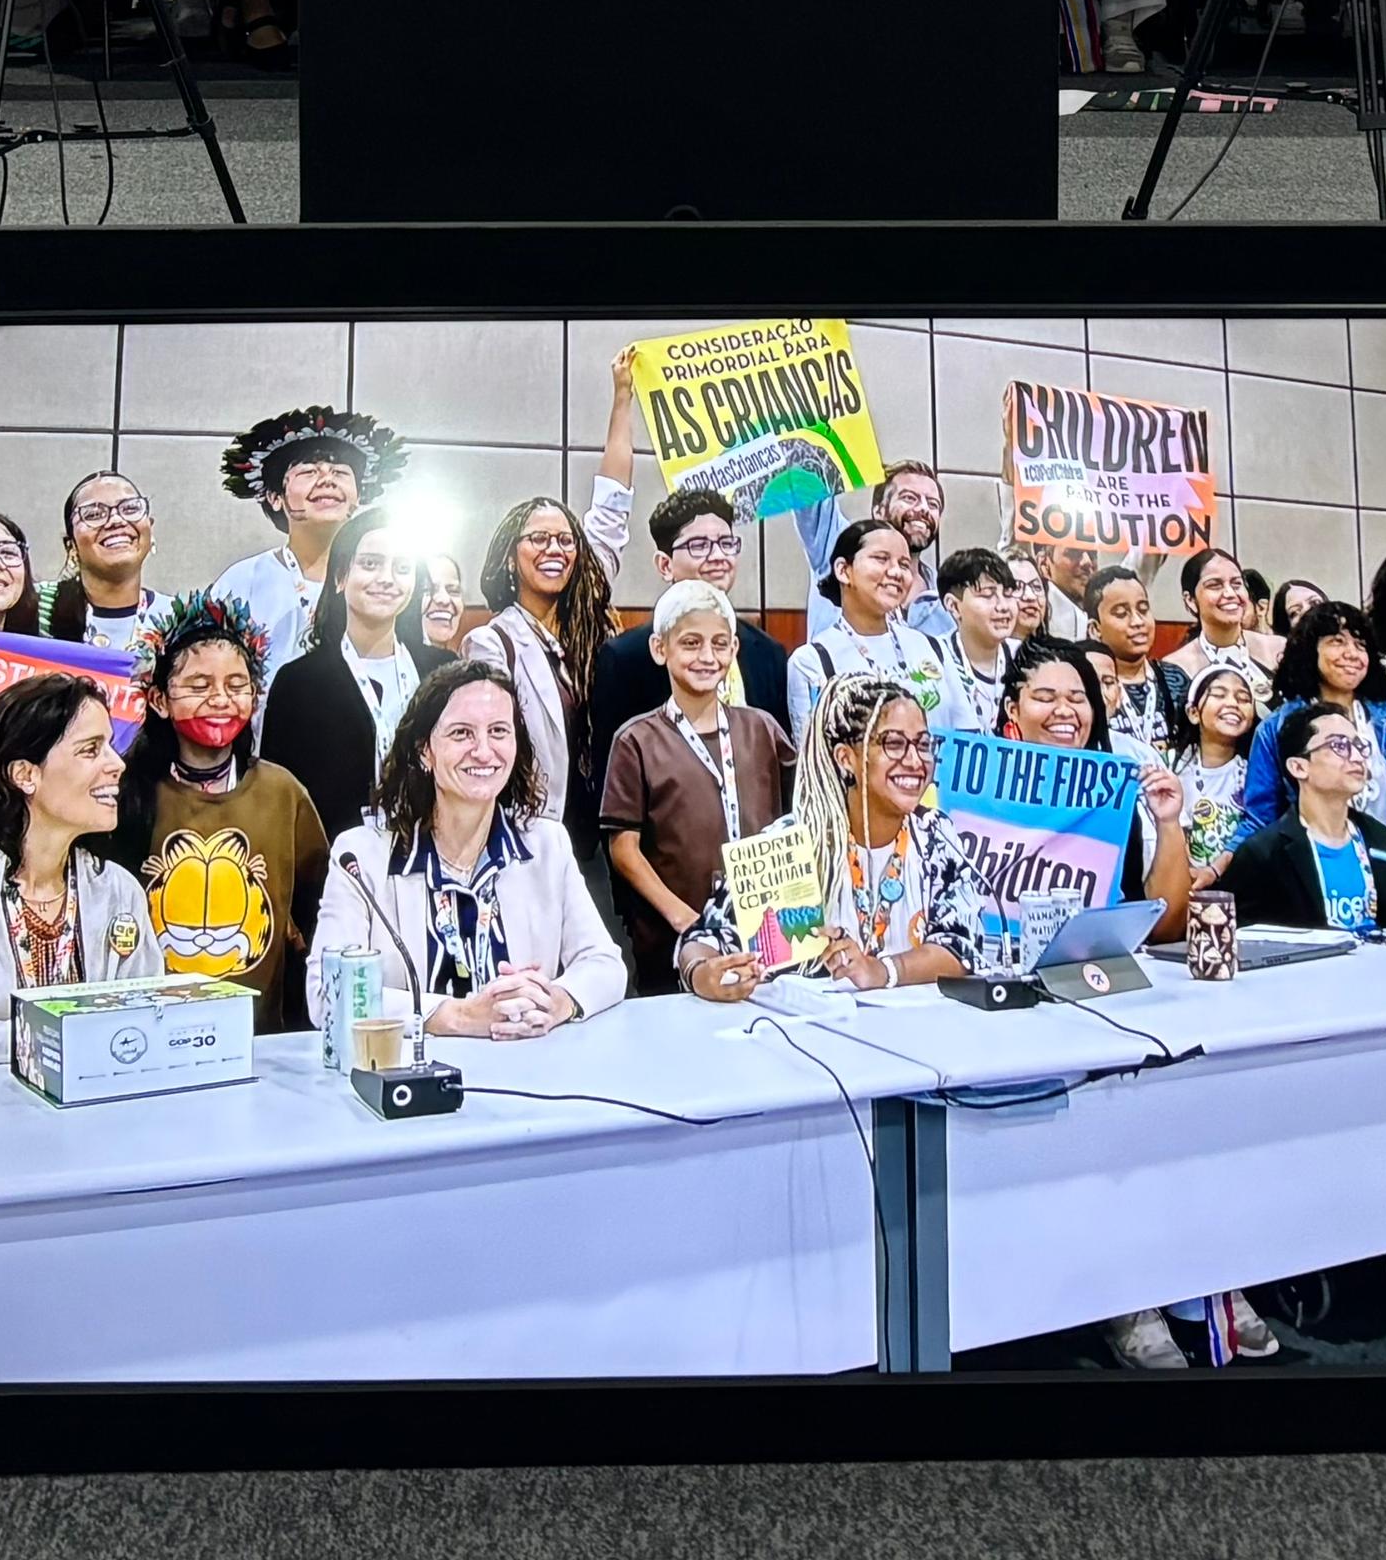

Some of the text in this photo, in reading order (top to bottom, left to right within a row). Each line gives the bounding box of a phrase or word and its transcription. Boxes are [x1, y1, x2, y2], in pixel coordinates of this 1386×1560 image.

[661, 333, 831, 382] PRIMORDIAL PARA
[649, 349, 862, 461] AS CRIANÇAS
[1013, 381, 1209, 474] CHILDREN
[1096, 474, 1129, 491] ARE
[1108, 492, 1130, 507] OF
[1136, 493, 1171, 508] THE
[1017, 500, 1211, 547] SOLUTION
[950, 739, 1140, 811] TO THE FIRST
[733, 850, 794, 881] AND THE
[735, 879, 757, 895] UN
